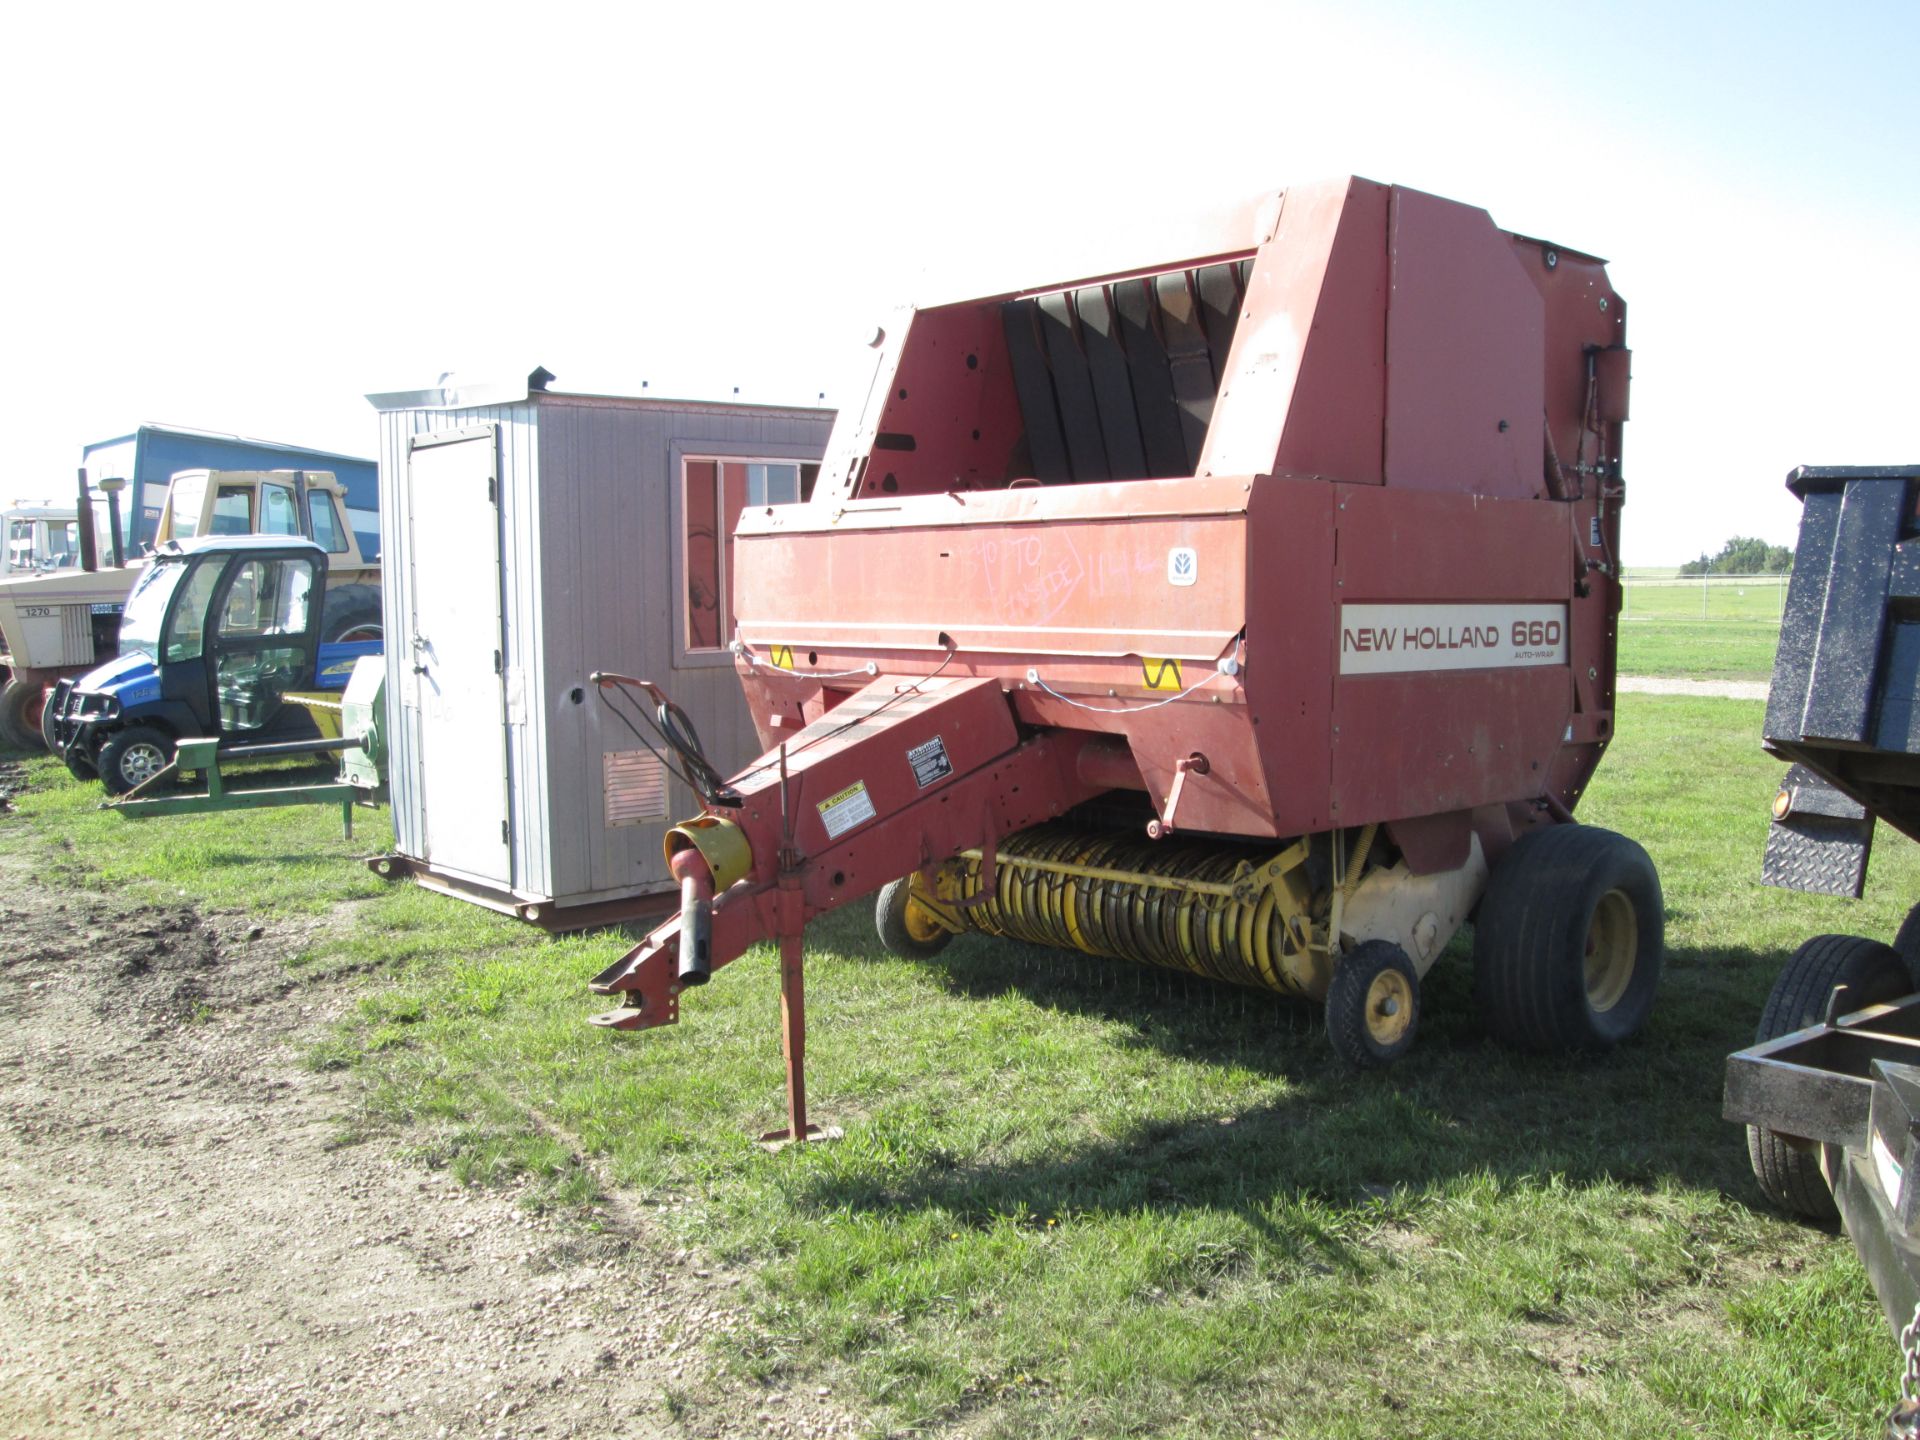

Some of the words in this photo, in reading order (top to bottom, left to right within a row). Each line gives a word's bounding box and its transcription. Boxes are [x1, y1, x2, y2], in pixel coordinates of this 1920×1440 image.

[25, 607, 50, 616] 1270
[1343, 628, 1397, 652] NEW
[1403, 626, 1499, 650] HOLLAND
[1511, 620, 1562, 647] 660
[1514, 650, 1554, 659] AUTO-WRAP
[832, 786, 858, 804] CAUTION
